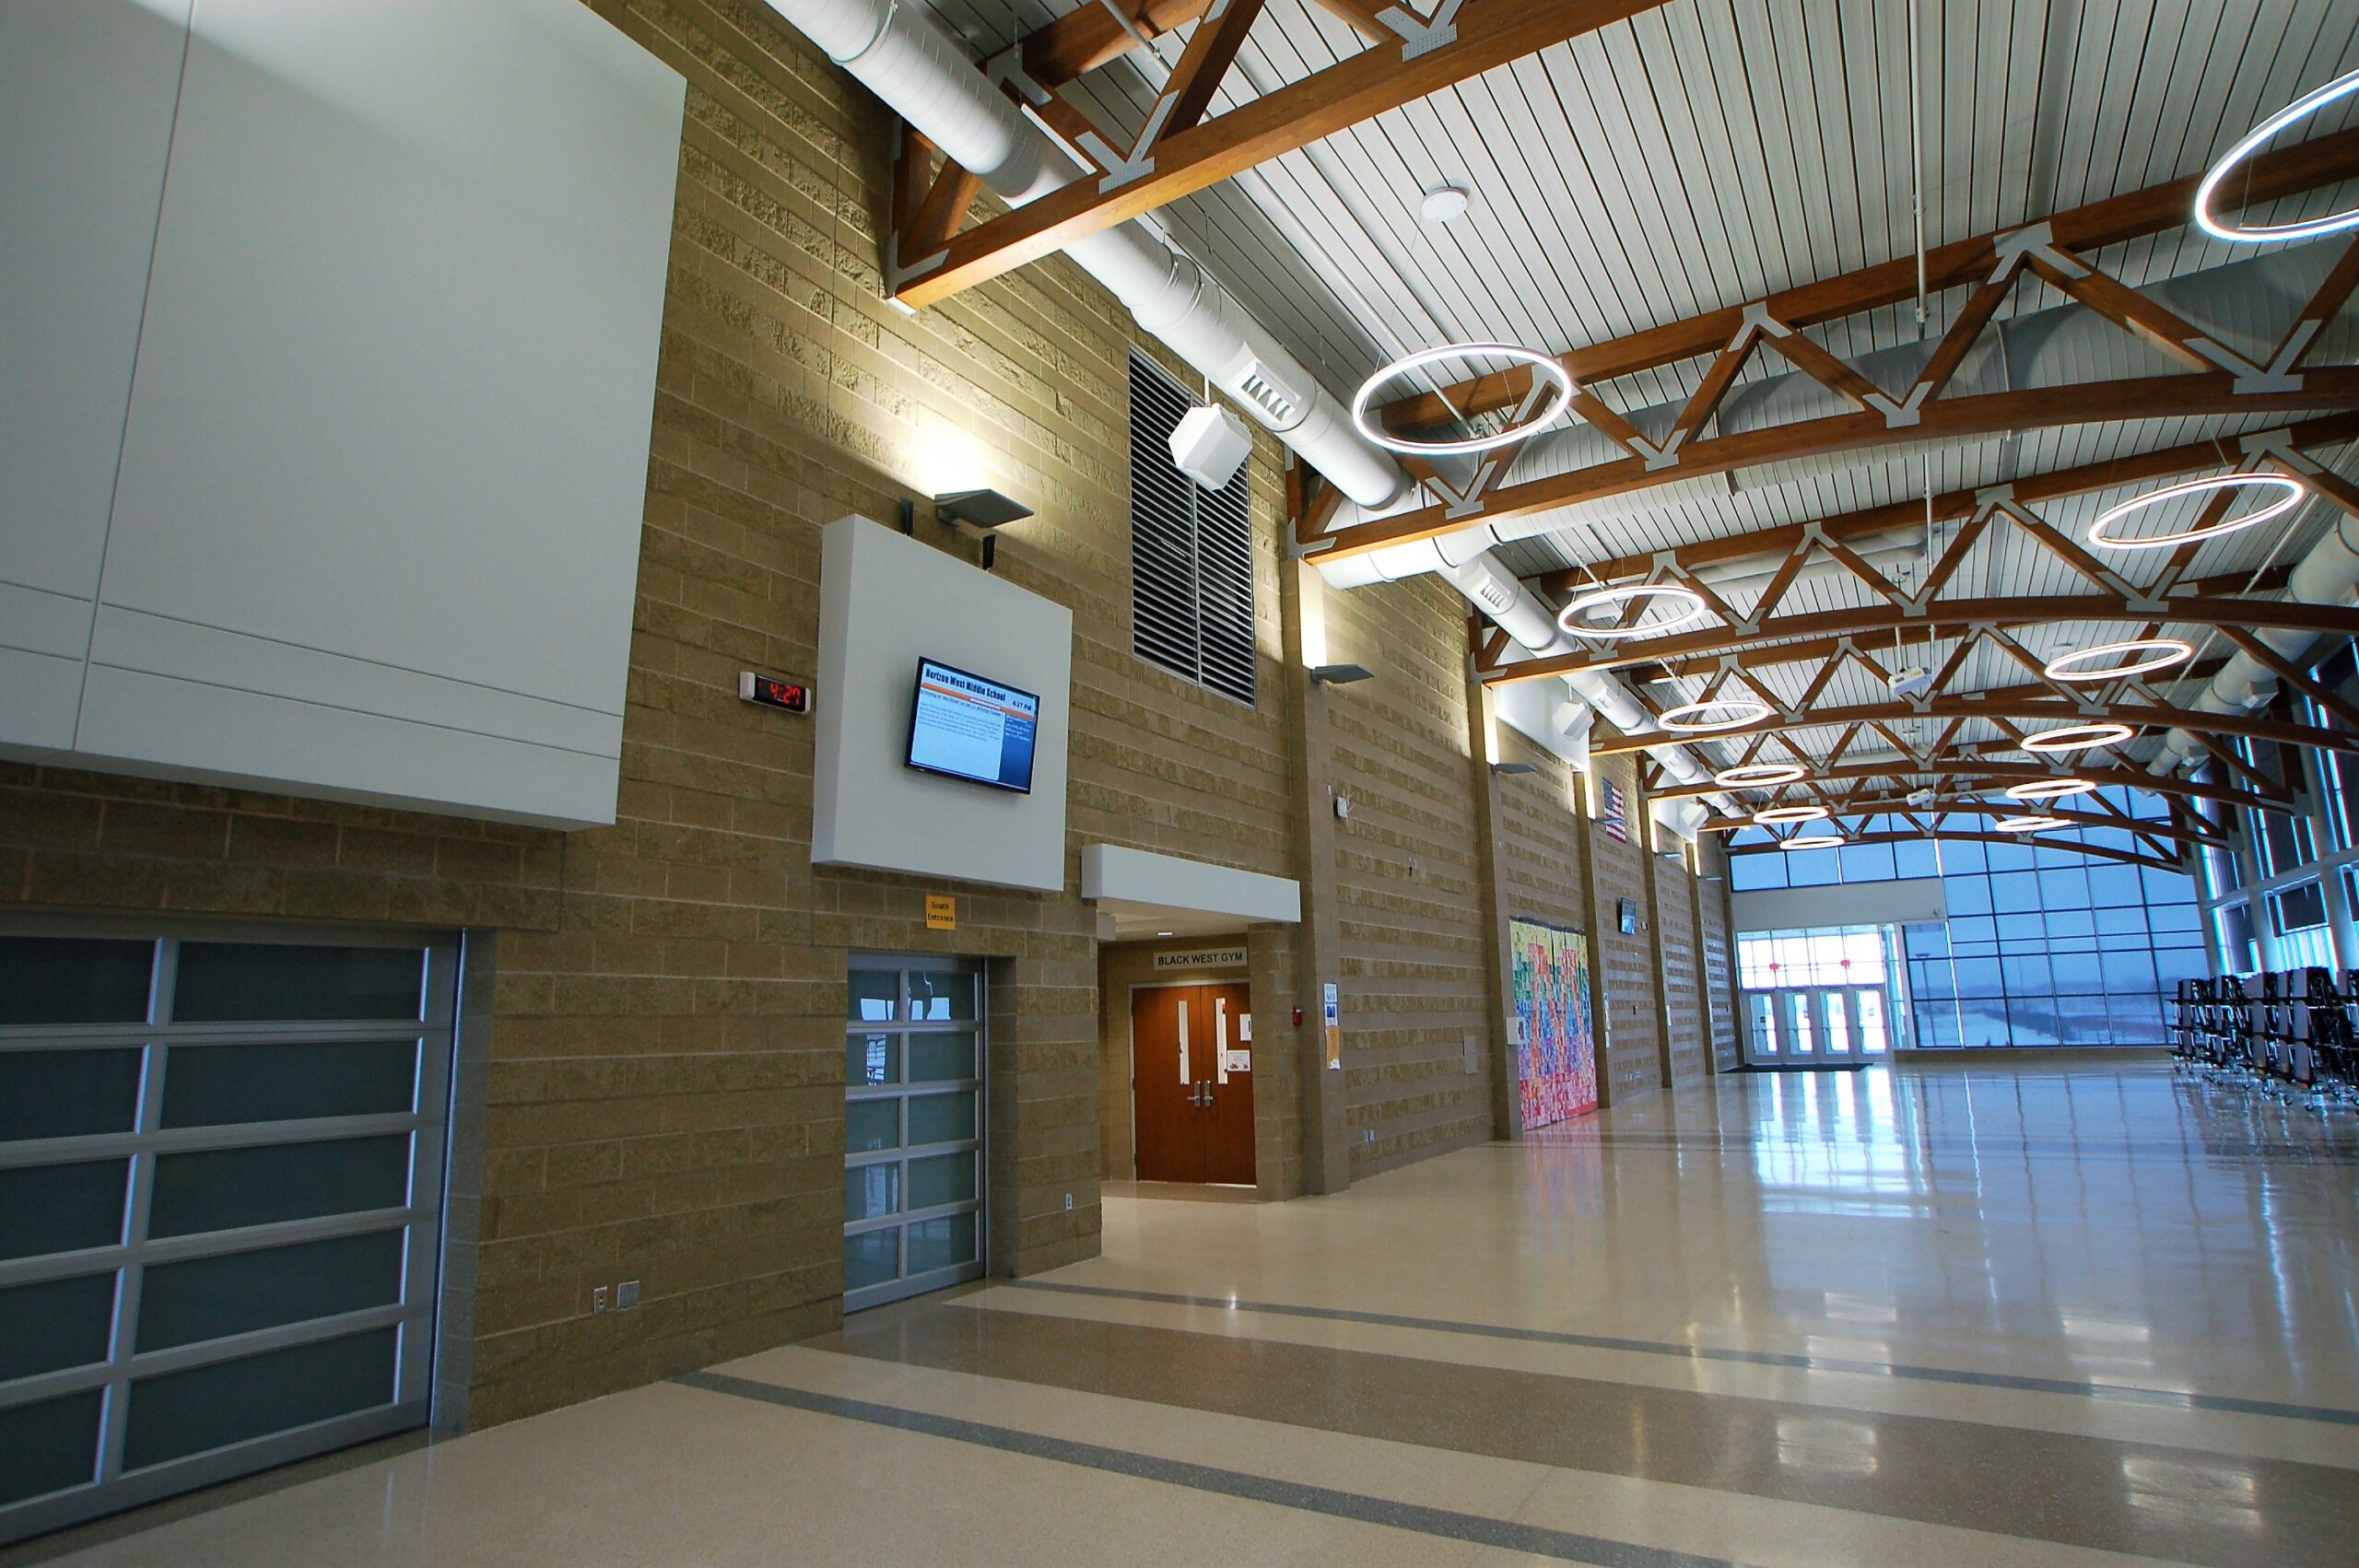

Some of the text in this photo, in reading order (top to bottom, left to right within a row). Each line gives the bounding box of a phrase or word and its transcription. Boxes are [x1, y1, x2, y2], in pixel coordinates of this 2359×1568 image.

[770, 683, 800, 705] 4:27
[950, 675, 965, 689] West
[966, 682, 985, 696] Middle
[987, 687, 1005, 702] School
[932, 901, 949, 910] South
[928, 913, 954, 922] Entrance
[1157, 952, 1243, 965] BLACK WEST GYM
